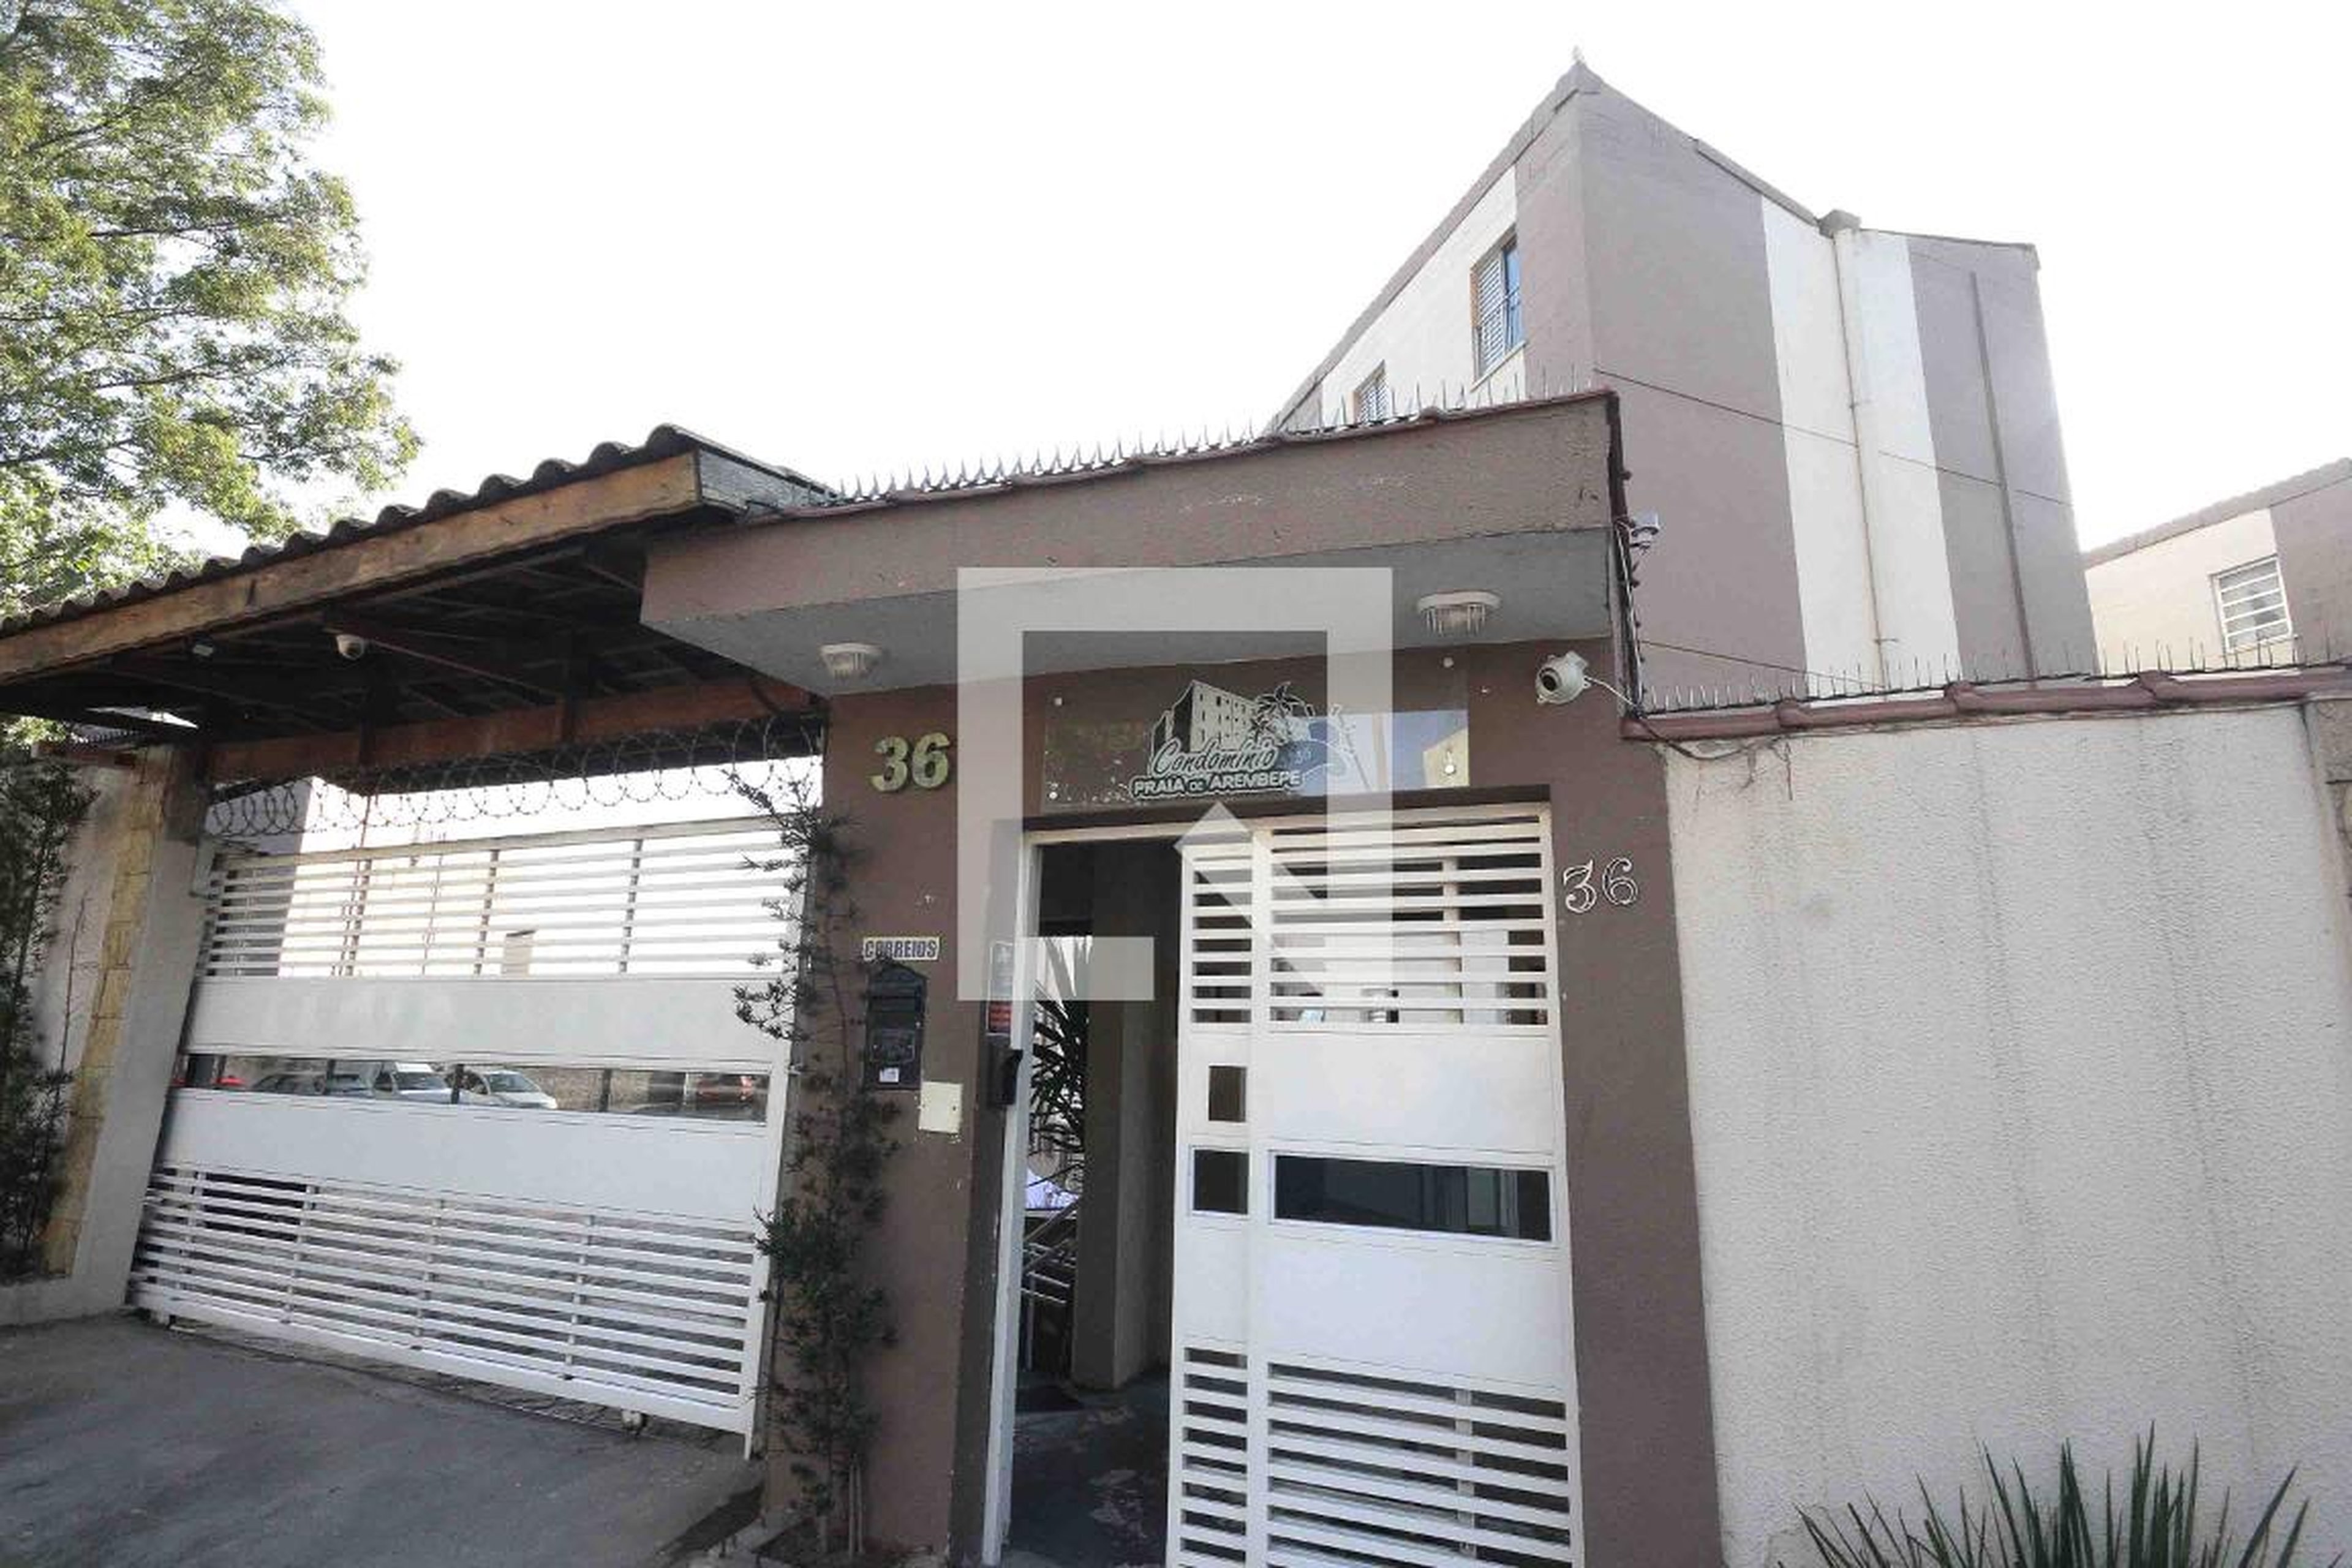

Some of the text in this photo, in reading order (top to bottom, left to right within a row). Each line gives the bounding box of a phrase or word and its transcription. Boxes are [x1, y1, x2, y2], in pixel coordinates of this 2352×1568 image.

[867, 733, 949, 791] 36
[1134, 777, 1185, 796] PRAIA
[1208, 770, 1300, 789] AREMBEPE
[1563, 858, 1638, 913] 36
[865, 940, 937, 958] CORREIOS
